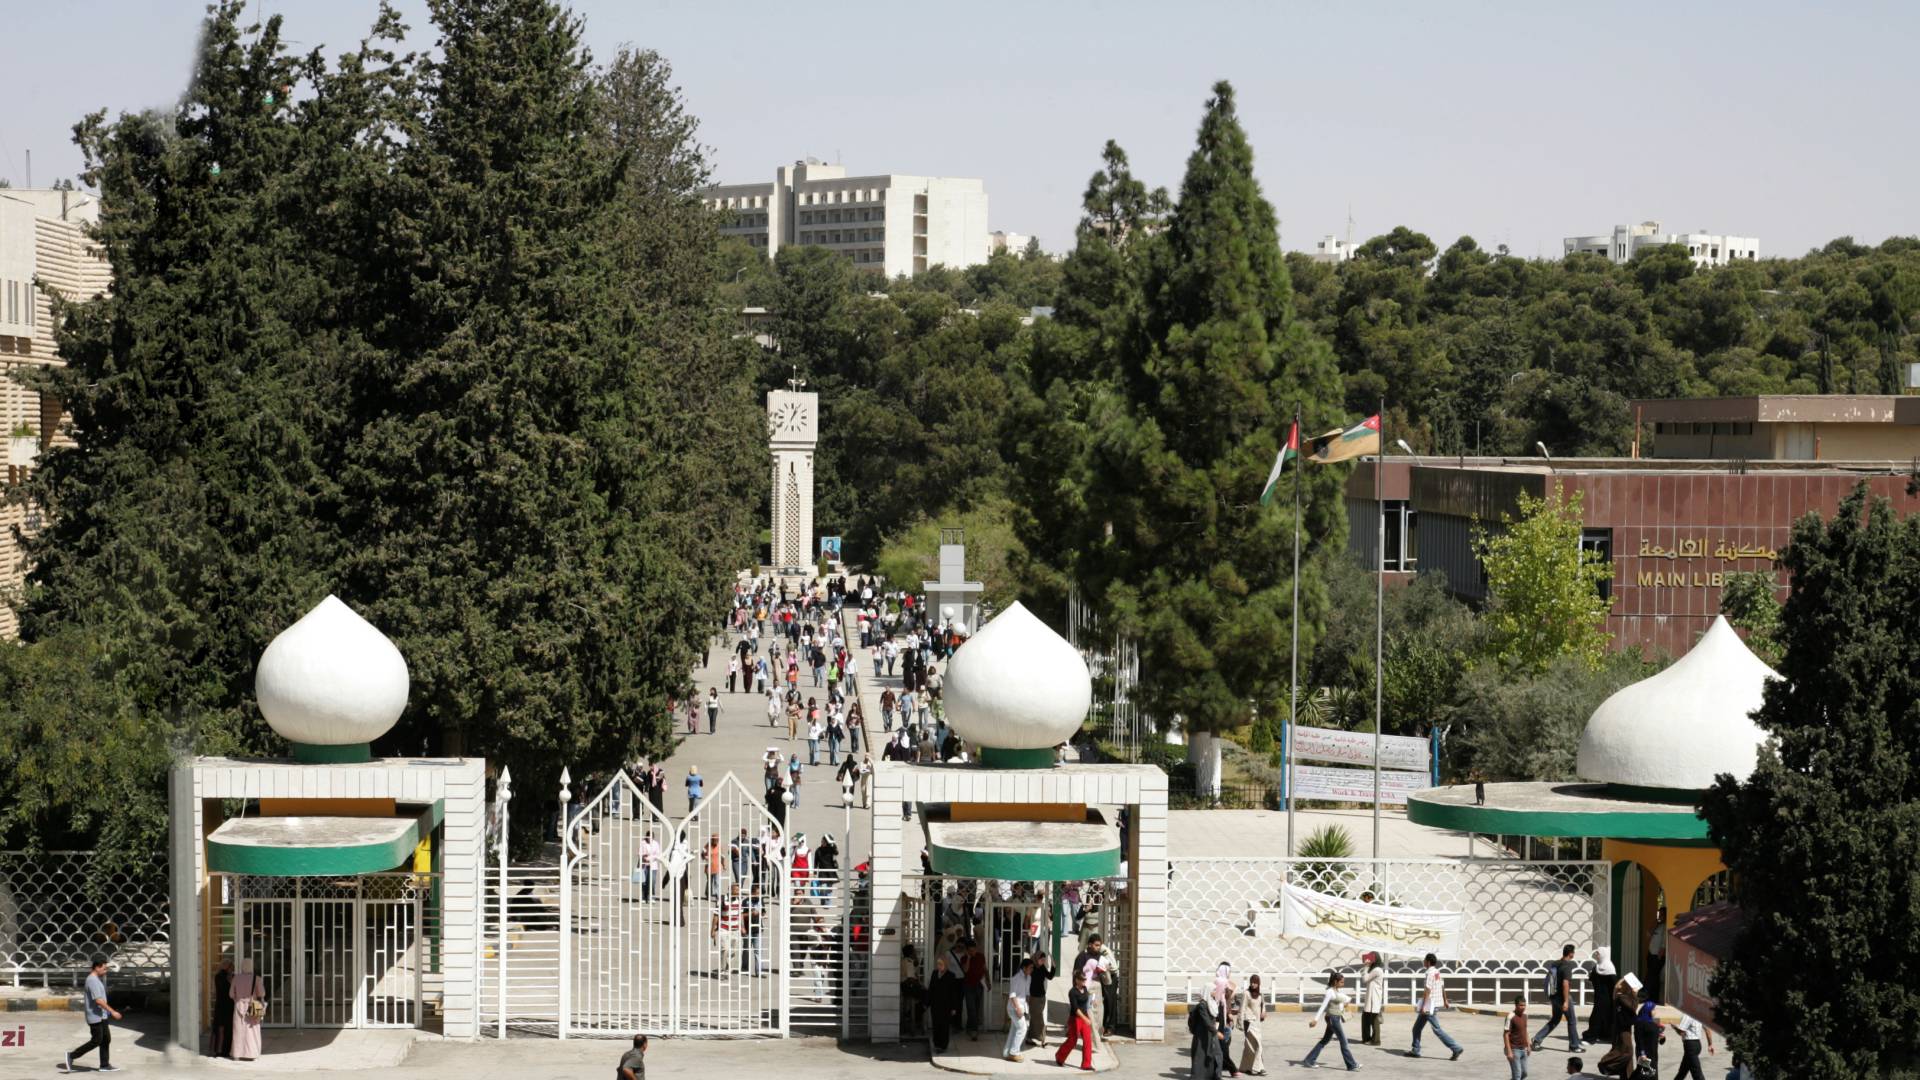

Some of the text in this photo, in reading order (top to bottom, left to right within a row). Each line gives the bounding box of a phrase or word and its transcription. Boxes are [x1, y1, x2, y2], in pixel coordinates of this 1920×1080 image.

[1639, 538, 1778, 563] مكتبة الجامعة
[1637, 572, 1686, 587] MAIN
[1349, 917, 1393, 937] الكتاب
[1393, 925, 1441, 944] معرض
